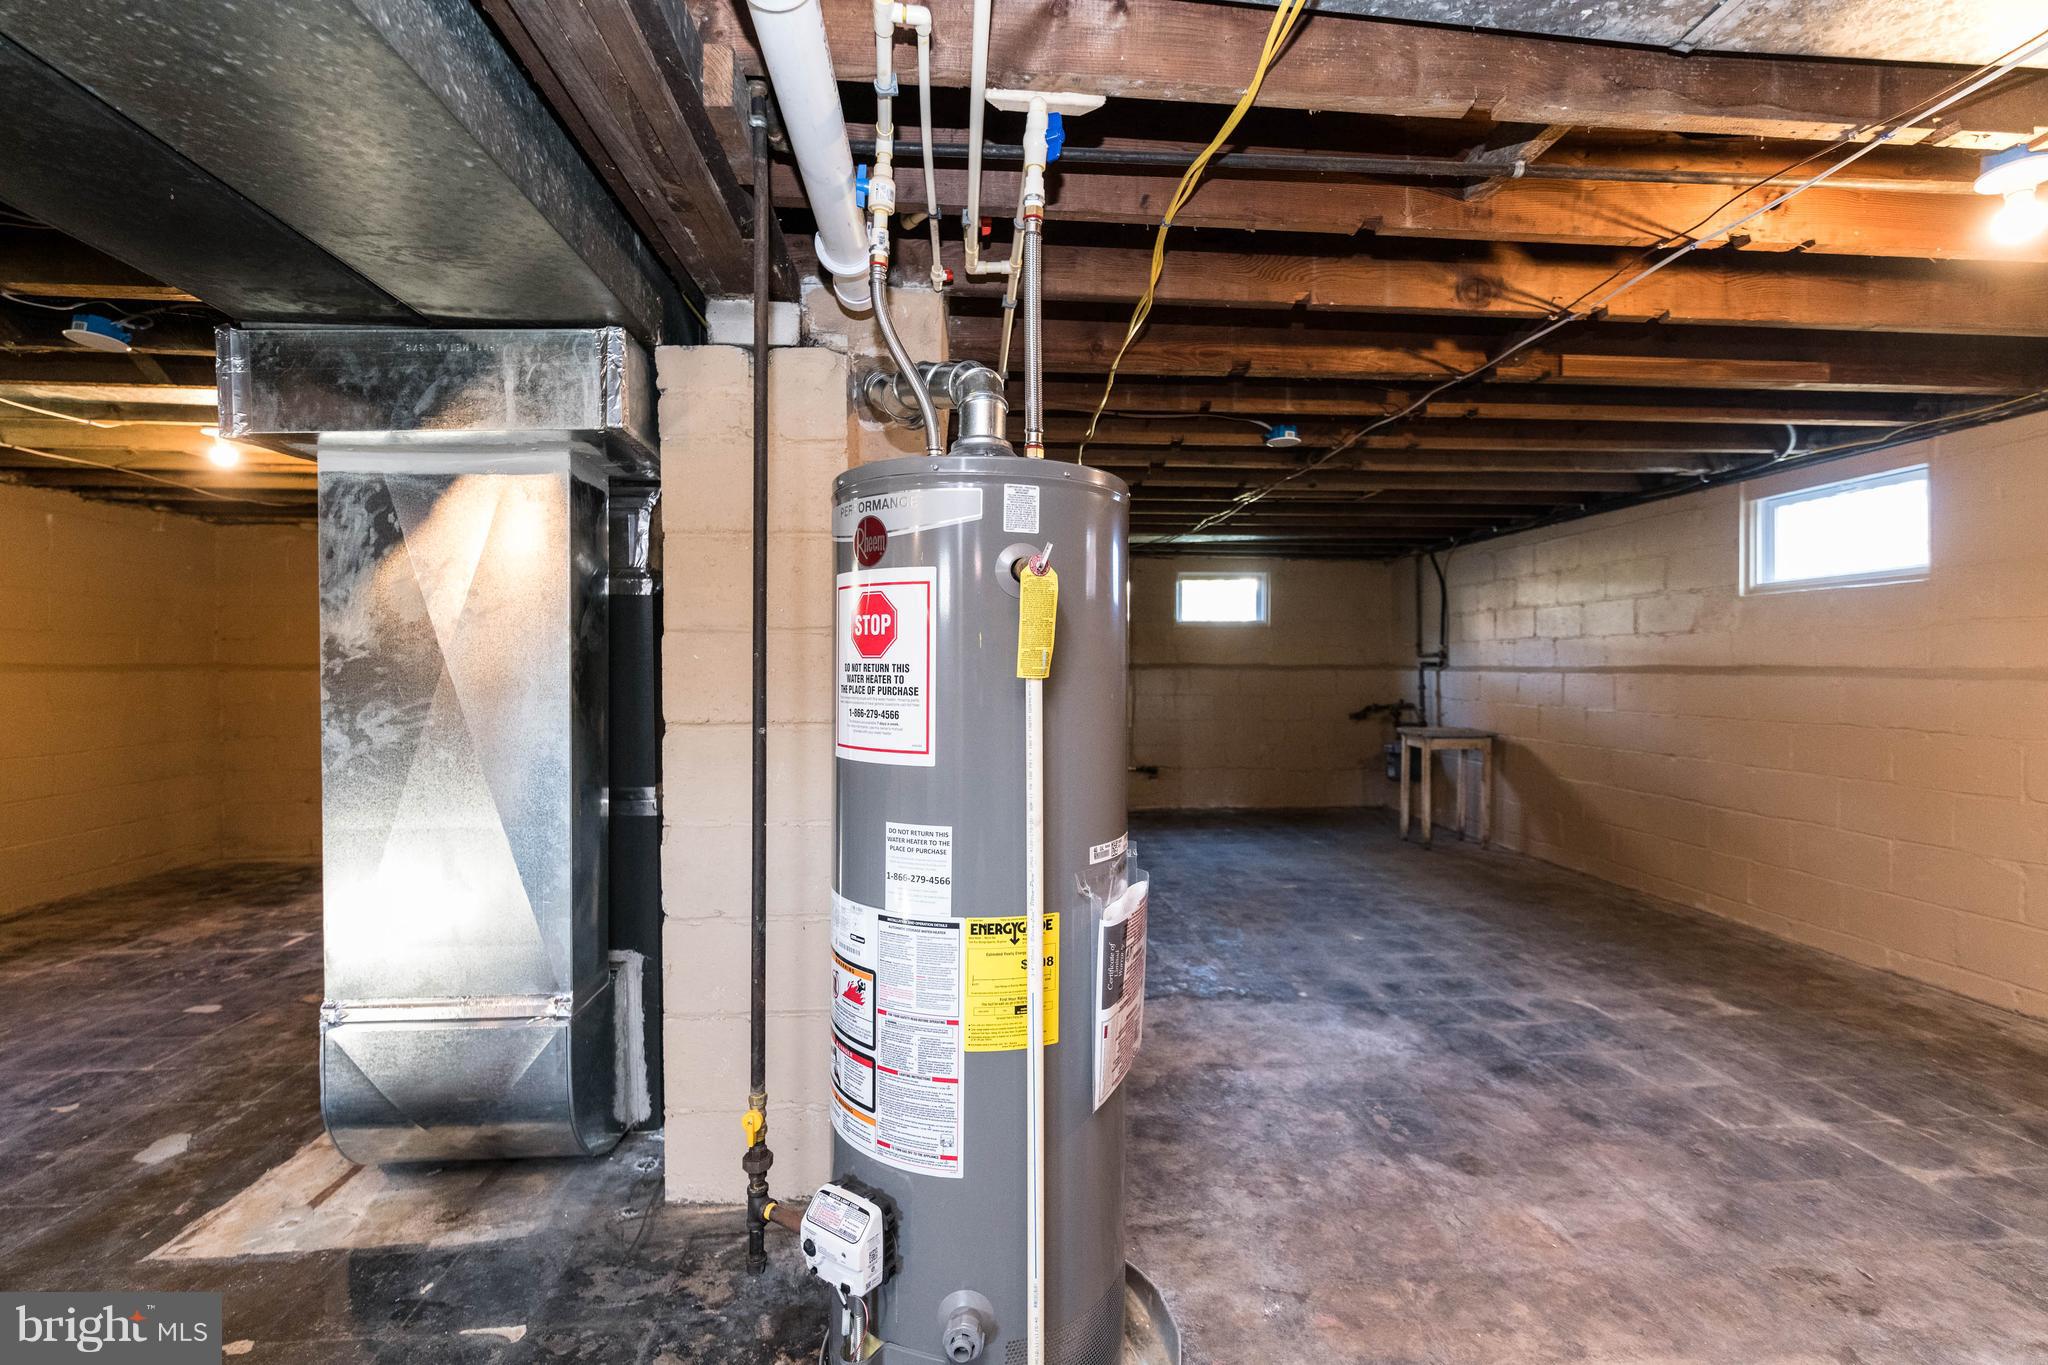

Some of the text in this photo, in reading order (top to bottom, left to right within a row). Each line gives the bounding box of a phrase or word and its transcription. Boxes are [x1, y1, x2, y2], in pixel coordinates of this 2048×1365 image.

[855, 520, 886, 560] Rheem
[854, 613, 892, 636] STOP
[844, 663, 910, 673] DO NOT RETURN THIS
[846, 674, 905, 684] WATER HEATER TO
[848, 685, 866, 695] PLACE
[867, 686, 876, 695] OF
[877, 687, 919, 696] PURCHASE
[849, 708, 900, 720] 1-866-279-4566
[906, 838, 928, 846] HEATER
[889, 845, 906, 853] PLACE
[886, 871, 951, 885] 1-866-279-4566
[1108, 942, 1116, 950] of
